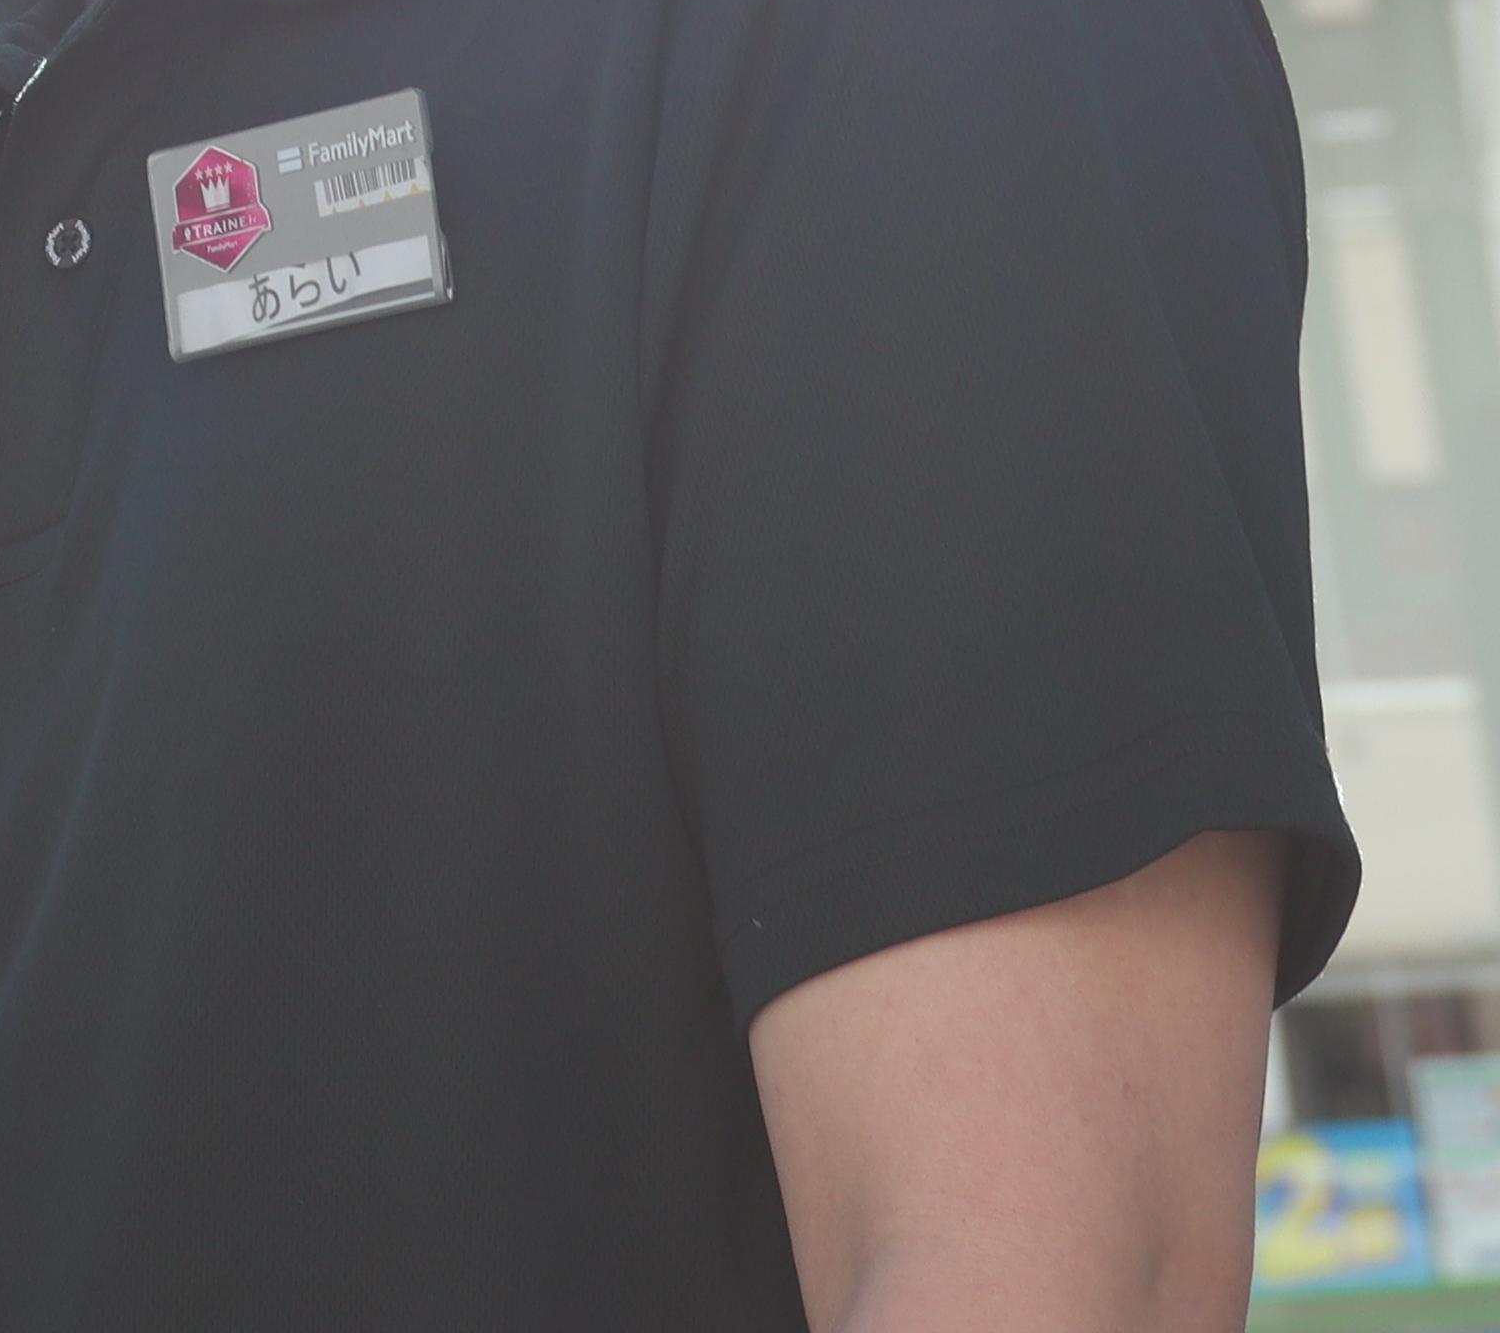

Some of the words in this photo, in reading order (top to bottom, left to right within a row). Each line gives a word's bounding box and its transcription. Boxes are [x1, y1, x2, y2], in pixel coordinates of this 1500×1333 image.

[308, 119, 415, 167] FamilyMart
[248, 250, 361, 323] あらい
